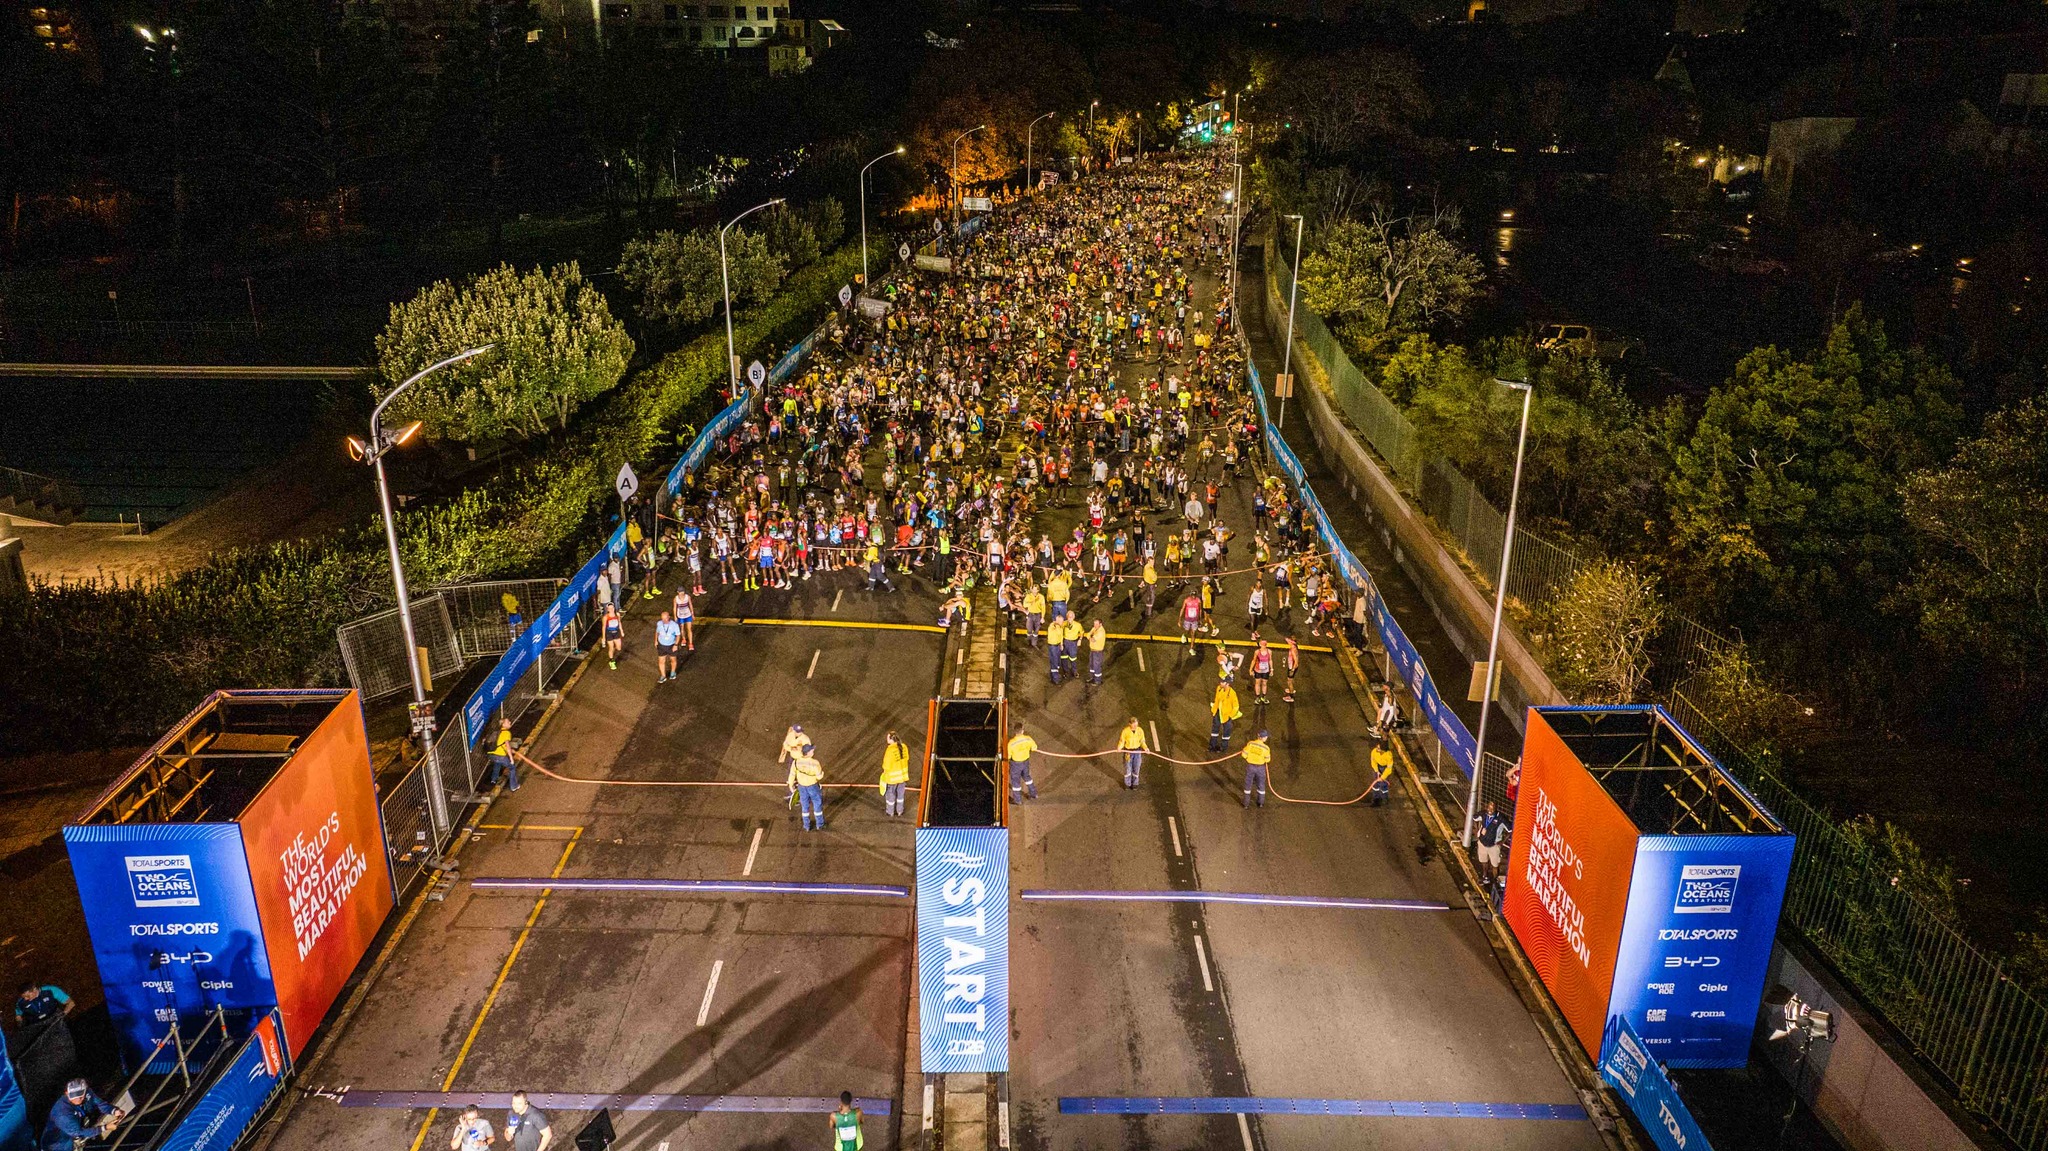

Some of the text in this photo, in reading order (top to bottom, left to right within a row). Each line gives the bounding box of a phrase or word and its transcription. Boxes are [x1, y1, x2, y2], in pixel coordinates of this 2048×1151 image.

[620, 477, 632, 490] A
[1538, 787, 1557, 820] THE
[1536, 803, 1583, 880] WORLD'S
[280, 831, 306, 873] THE
[283, 811, 340, 892] WORLD'S
[1532, 824, 1564, 877] MOST
[132, 859, 185, 867] TOTALSPORTS
[135, 873, 167, 882] TWO
[1688, 868, 1735, 876] TOTALSPORTS
[138, 882, 191, 891] OCEANS
[288, 853, 325, 917] MOST
[293, 843, 358, 939] BEAUTIFUL
[1528, 844, 1585, 937] BEAUTIFUL
[1685, 882, 1712, 890] TWO
[1683, 890, 1731, 899] OCEANS
[297, 852, 367, 962] MARATHON
[1526, 863, 1591, 969] MARATHON
[129, 922, 219, 936] TOTALSPORTS
[1658, 929, 1738, 940] TOTALSPORTS
[943, 877, 985, 1031] START
[1664, 956, 1720, 967] BYD
[201, 980, 233, 990] Cipla
[1698, 984, 1728, 993] Cipla
